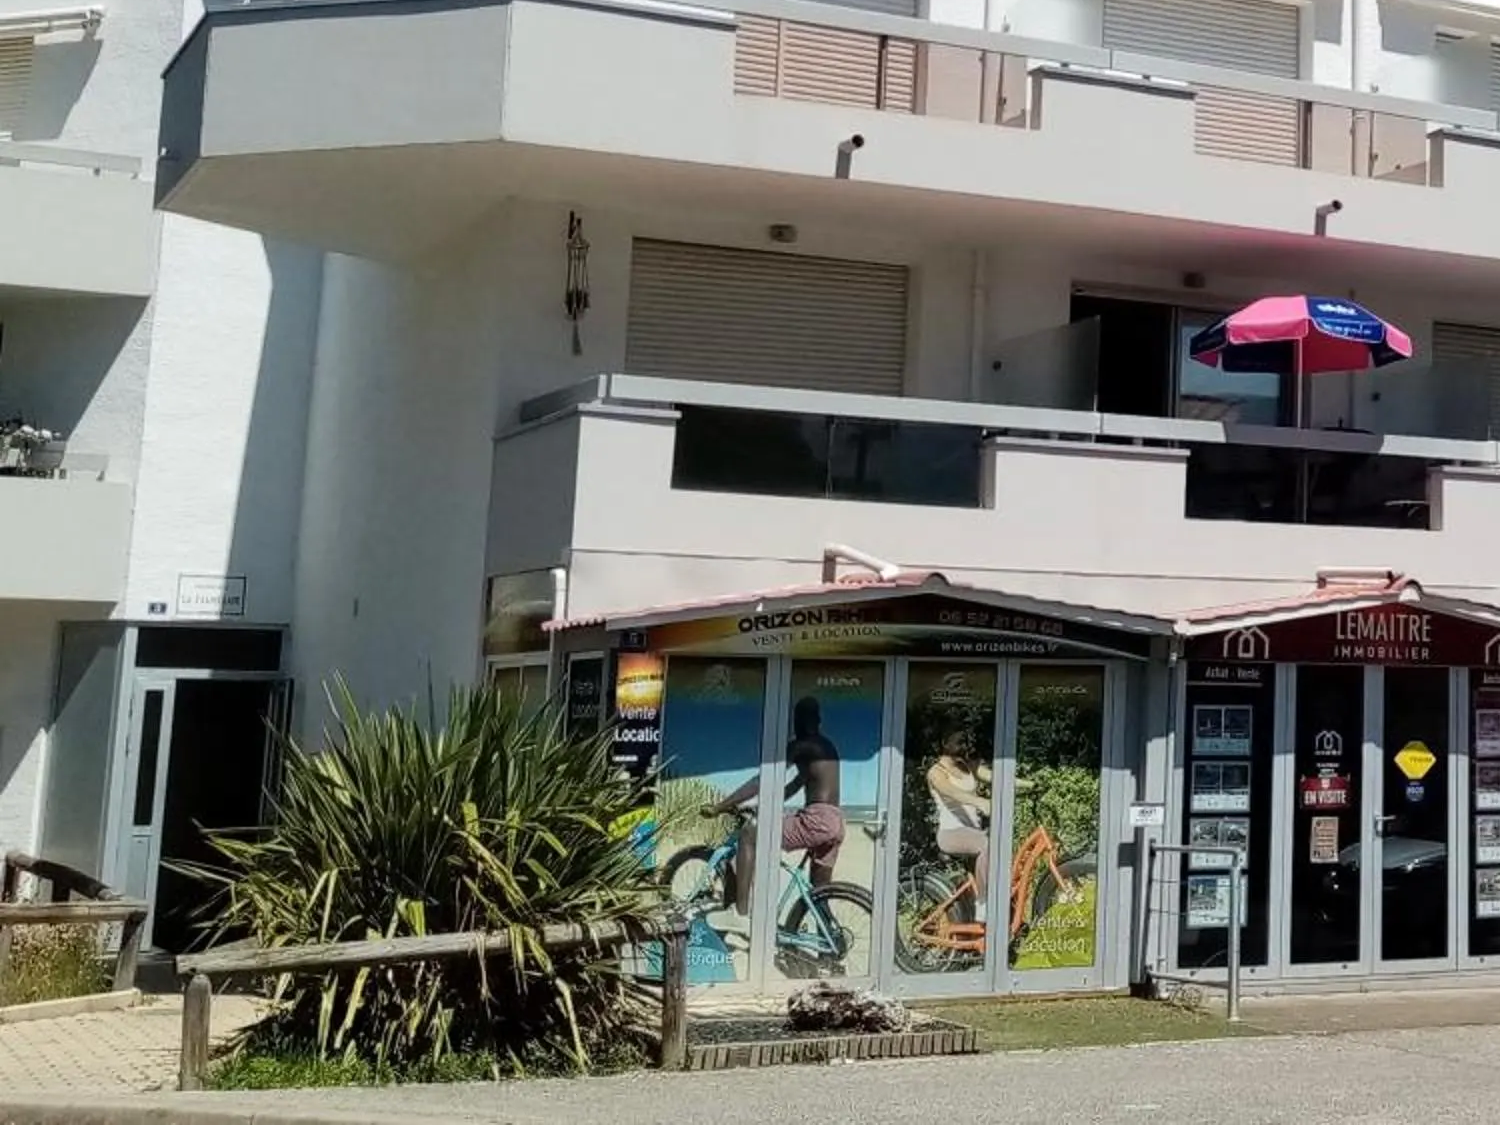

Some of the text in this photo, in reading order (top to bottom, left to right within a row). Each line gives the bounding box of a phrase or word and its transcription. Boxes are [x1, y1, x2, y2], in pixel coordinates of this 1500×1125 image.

[738, 608, 823, 633] ORIZON
[1335, 610, 1433, 643] LEMAITRE
[752, 633, 794, 647] VENTE
[814, 623, 882, 640] LOCATION
[1333, 645, 1431, 661] IMMOBILIER
[618, 703, 658, 721] Vente
[1319, 789, 1346, 805] VISITE
